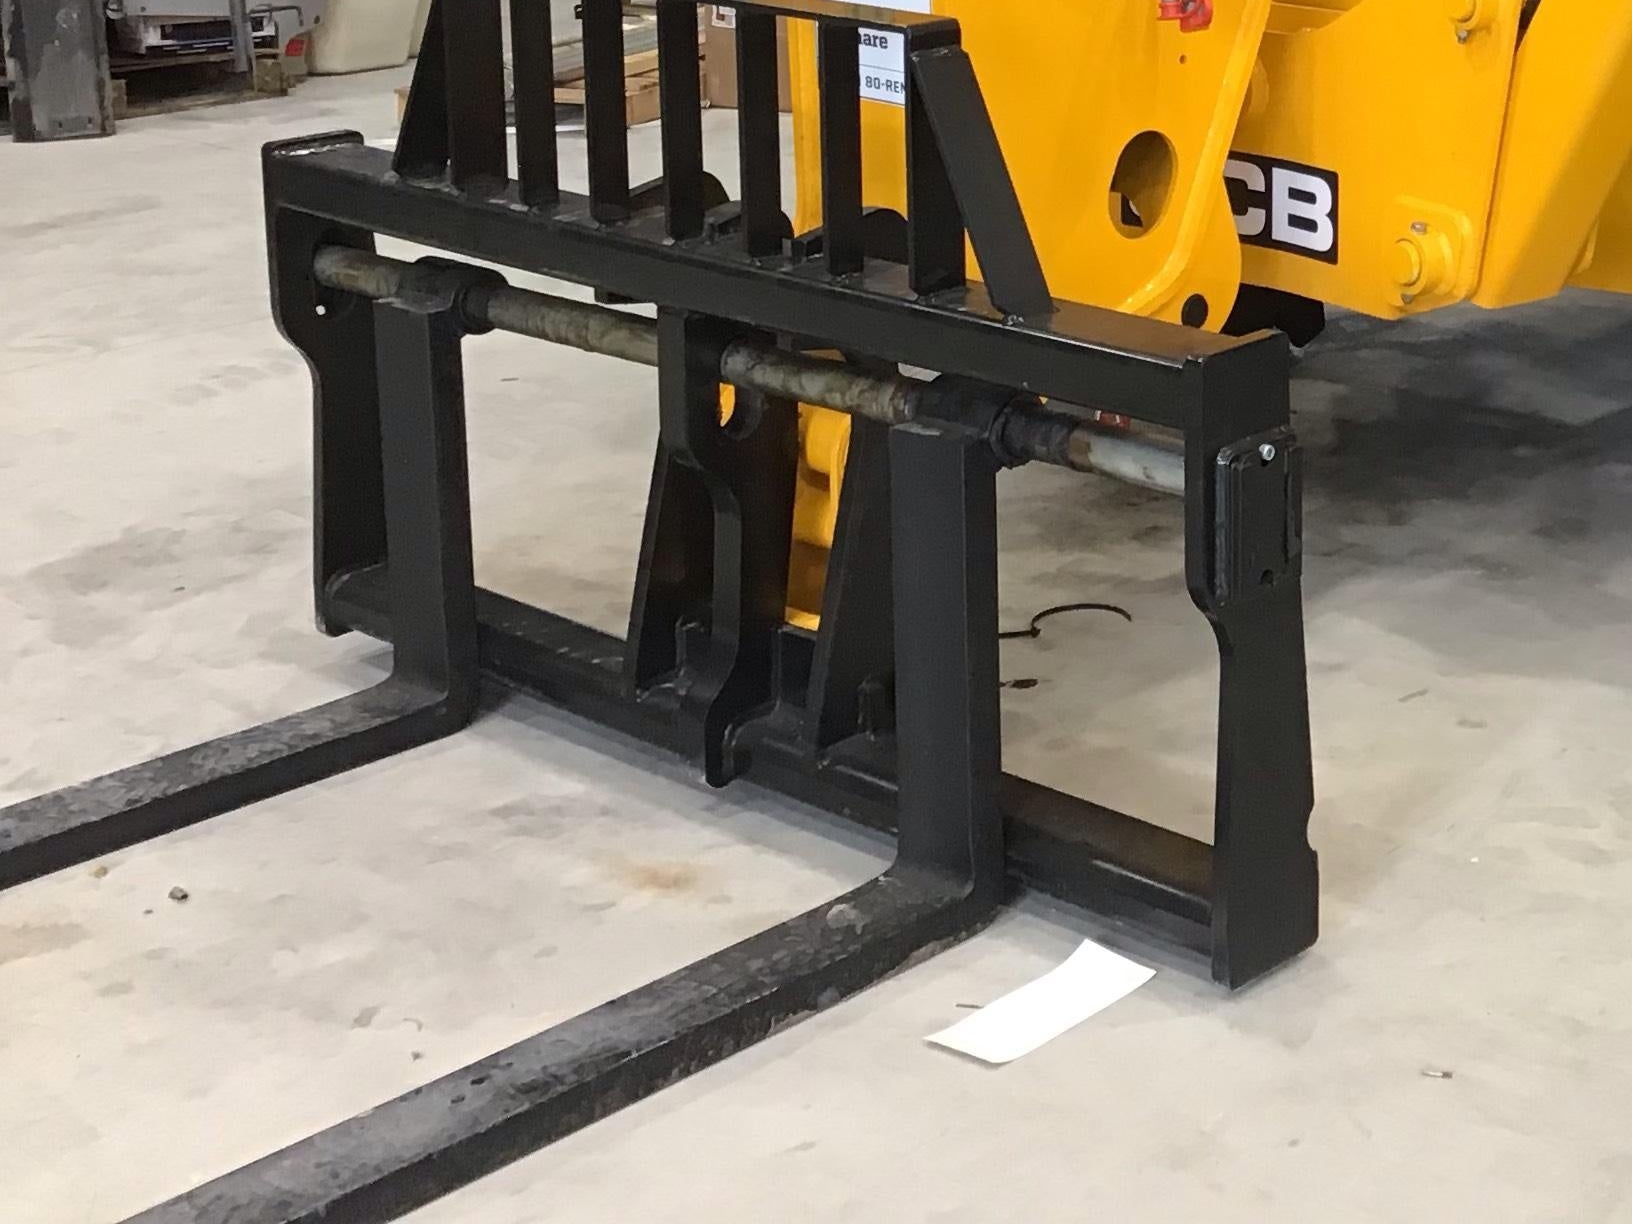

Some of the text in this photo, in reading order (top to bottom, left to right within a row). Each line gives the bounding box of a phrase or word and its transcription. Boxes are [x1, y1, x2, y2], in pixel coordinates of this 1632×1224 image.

[860, 33, 888, 49] are
[865, 75, 905, 95] 80-REN
[1222, 159, 1334, 252] CB
